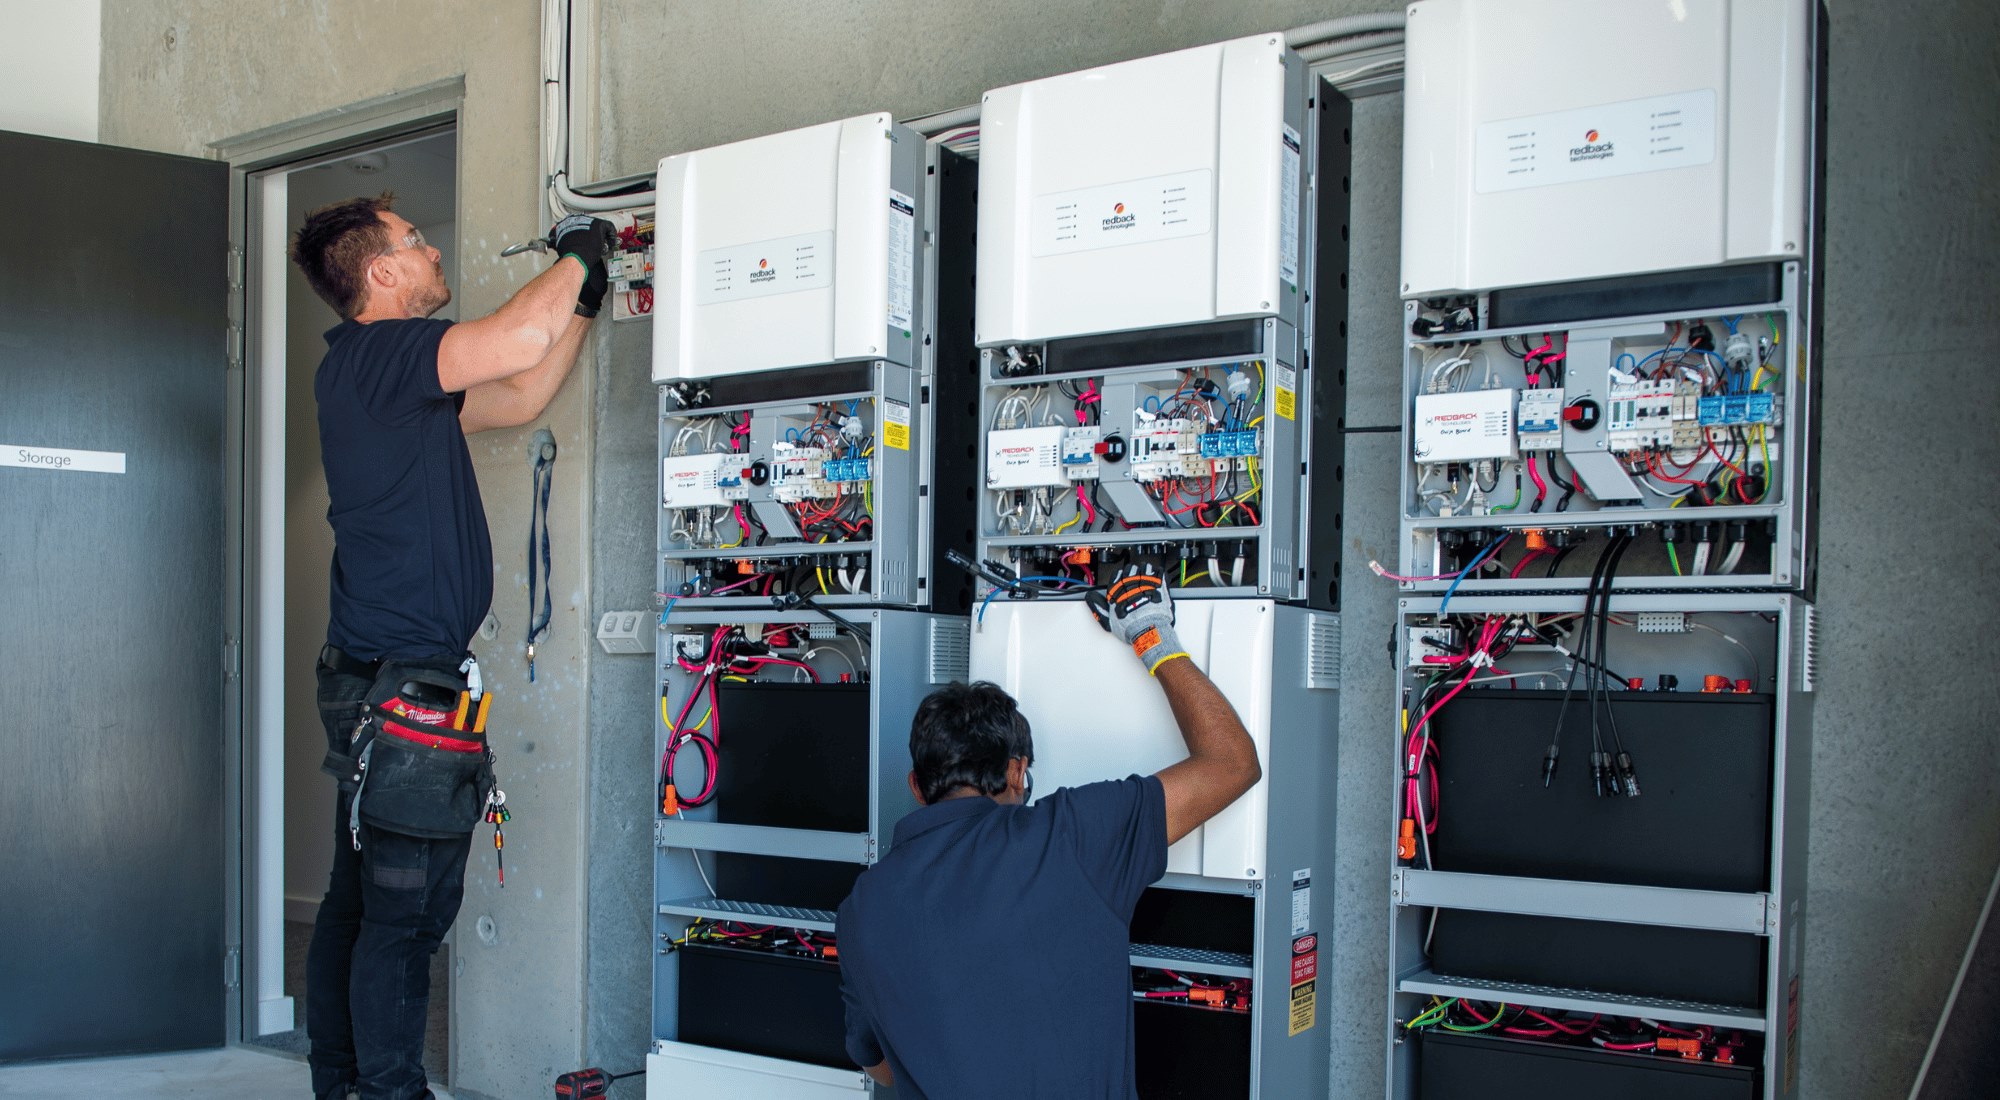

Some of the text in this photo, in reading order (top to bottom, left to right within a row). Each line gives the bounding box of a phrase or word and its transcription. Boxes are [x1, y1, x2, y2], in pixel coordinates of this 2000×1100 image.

[1569, 141, 1614, 156] redback
[1569, 152, 1614, 162] technologies
[1102, 213, 1136, 226] redback
[1102, 222, 1136, 231] technologies
[750, 268, 776, 279] redback
[1434, 413, 1478, 422] REDBACK
[18, 449, 72, 469] Storage
[406, 708, 446, 722] Milwaukee
